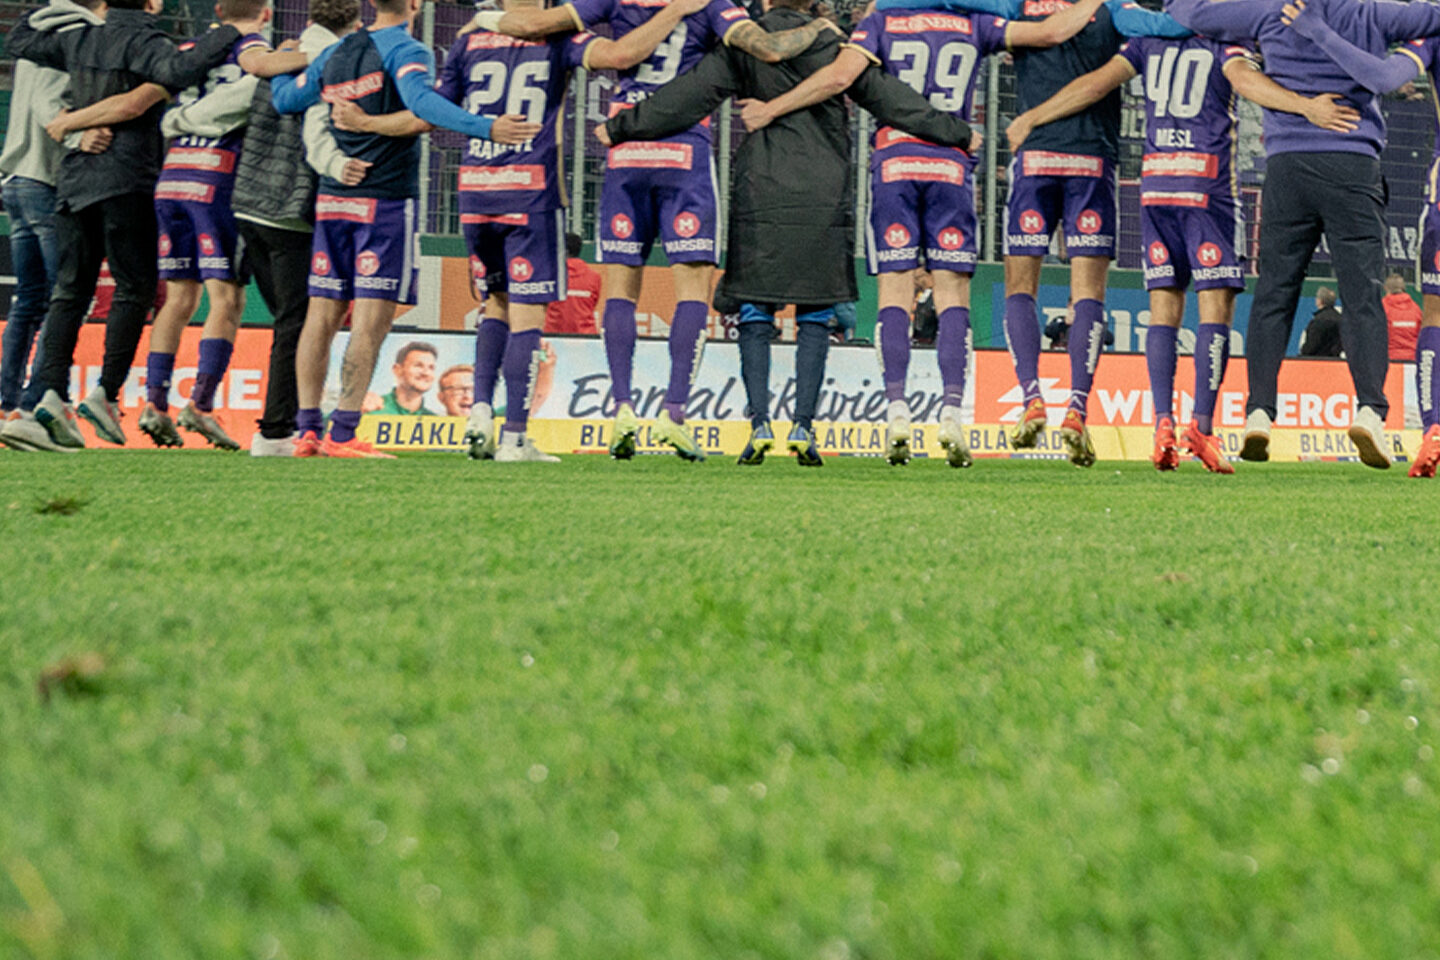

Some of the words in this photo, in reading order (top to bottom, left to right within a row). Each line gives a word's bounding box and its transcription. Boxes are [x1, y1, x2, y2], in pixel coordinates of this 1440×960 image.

[468, 60, 551, 128] 26
[888, 40, 978, 112] 39
[1146, 46, 1214, 118] 40
